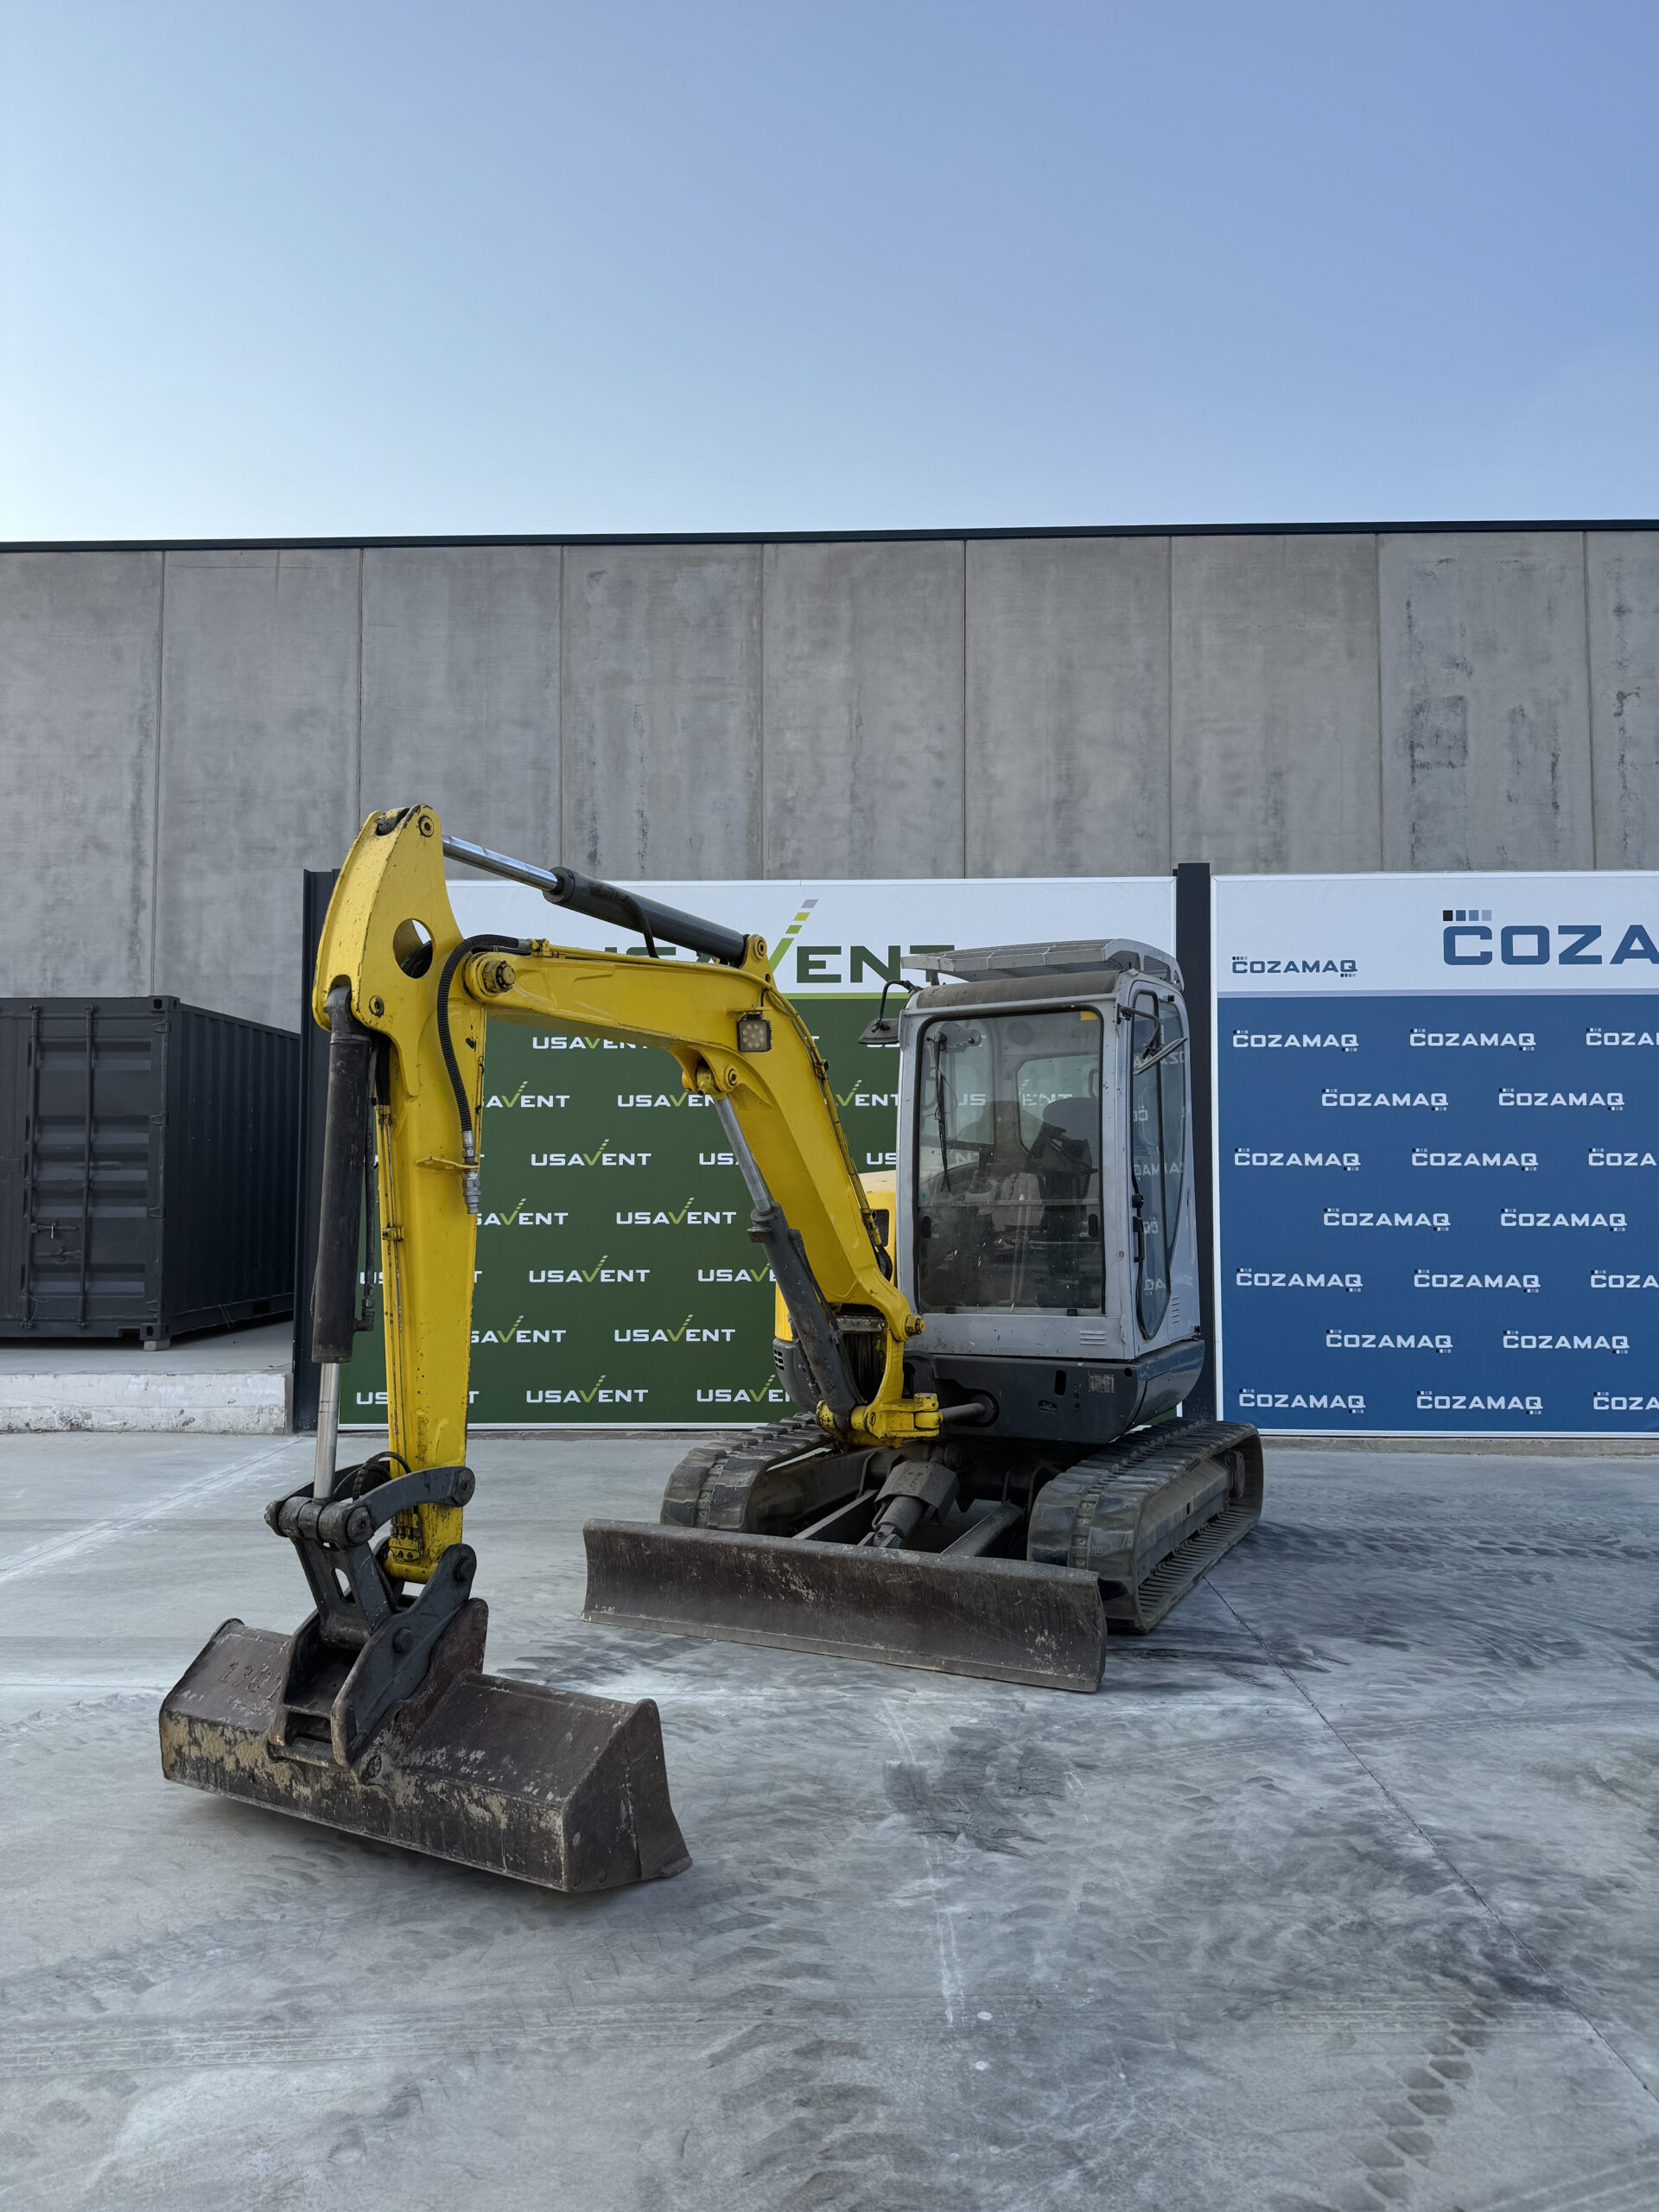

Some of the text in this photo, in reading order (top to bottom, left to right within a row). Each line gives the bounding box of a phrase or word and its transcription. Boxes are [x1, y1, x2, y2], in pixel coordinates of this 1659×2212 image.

[1443, 924, 1659, 966] COZA
[1232, 959, 1358, 974] COZAMAQ
[532, 1036, 647, 1050] USAVE
[1232, 1033, 1359, 1048] COZAMAQ
[1409, 1033, 1536, 1046] COZAMAQ
[1586, 1032, 1659, 1046] COZA
[483, 1092, 570, 1109] AVENT
[1321, 1092, 1449, 1107] COZAMAQ
[1498, 1092, 1625, 1106] COZAMAQ
[531, 1150, 652, 1166] USAVENT
[1234, 1153, 1361, 1166] COZAMAQ
[1411, 1153, 1539, 1166] COZAMAQ
[1588, 1153, 1657, 1166] COZA
[478, 1210, 569, 1226] AVENT
[615, 1209, 737, 1225] USAVENT
[1323, 1212, 1452, 1227] COZAMAQ
[1500, 1213, 1628, 1227] COZAMAQ
[528, 1267, 651, 1283] USAVENT
[1236, 1273, 1363, 1287] COZAMAQ
[1414, 1274, 1541, 1288] COZAMAQ
[471, 1327, 567, 1344] SAVENT
[613, 1326, 736, 1343] USAVENT
[1325, 1334, 1453, 1349] COZAMAQ
[1503, 1335, 1630, 1350] COZAMAQ
[526, 1387, 649, 1403] USAVENT
[696, 1386, 791, 1402] USAVE
[1239, 1393, 1366, 1408] COZAMAQ
[1416, 1395, 1543, 1410] COZAMAQ
